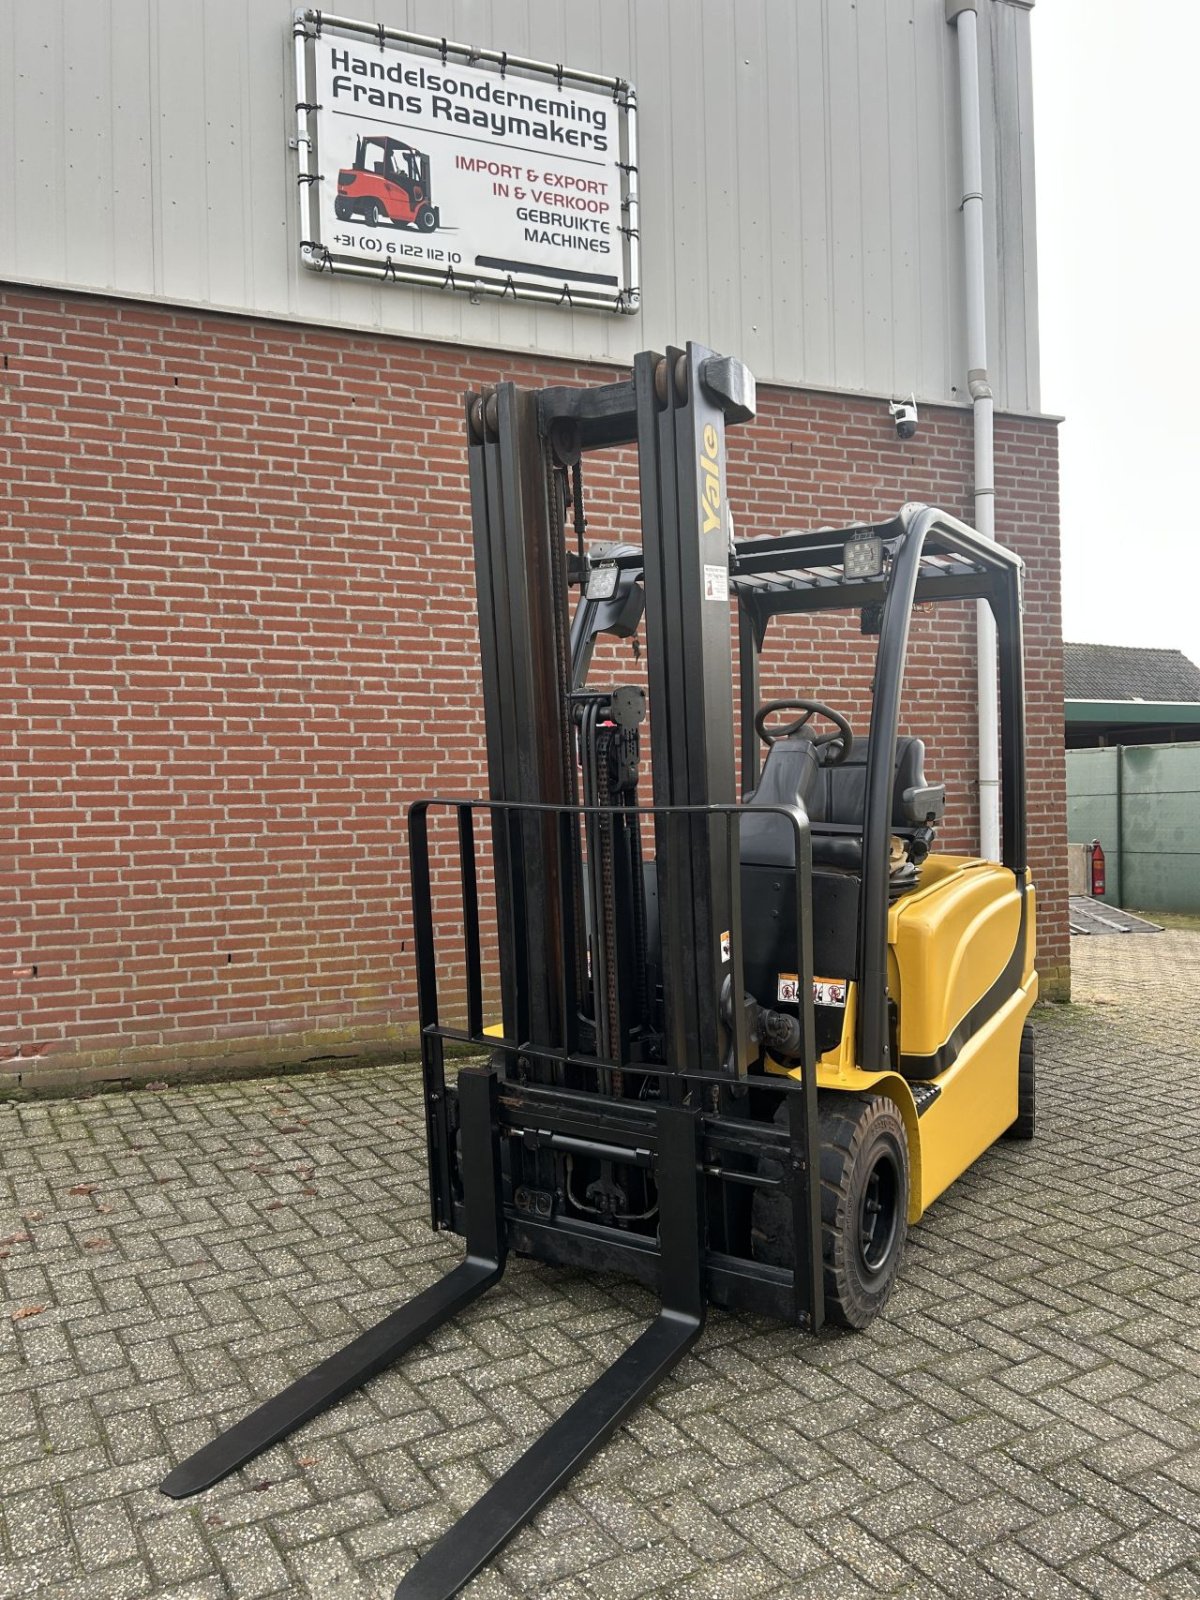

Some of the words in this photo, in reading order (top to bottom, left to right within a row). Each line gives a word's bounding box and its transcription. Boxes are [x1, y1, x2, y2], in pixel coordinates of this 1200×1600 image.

[331, 48, 607, 131] Handelsonderneming
[332, 75, 422, 114] Frans
[432, 95, 608, 152] Raaymakers
[455, 155, 522, 179] IMPORT
[527, 169, 539, 182] &
[543, 172, 608, 195] EXPORT
[493, 182, 509, 197] IN
[514, 186, 526, 199] &
[531, 189, 609, 214] VERKOOP
[516, 207, 610, 235] GEBRUIKTE
[333, 234, 355, 247] +31
[359, 236, 382, 252] (0)
[386, 242, 396, 253] 6
[400, 244, 423, 258] 122
[427, 248, 444, 261] 112
[448, 251, 462, 264] 10
[524, 228, 610, 254] MACHINES
[700, 423, 721, 534] Yale
